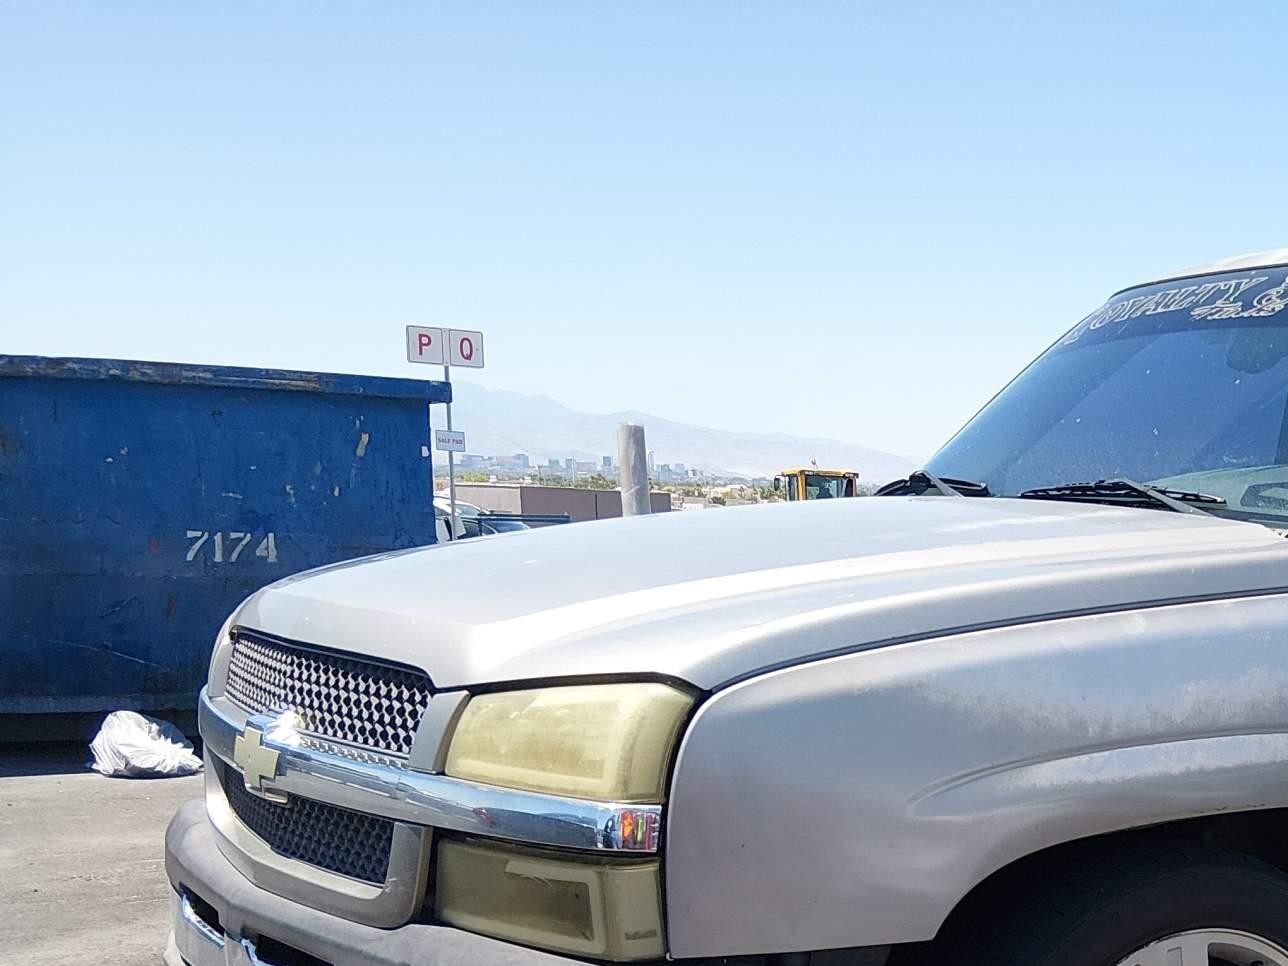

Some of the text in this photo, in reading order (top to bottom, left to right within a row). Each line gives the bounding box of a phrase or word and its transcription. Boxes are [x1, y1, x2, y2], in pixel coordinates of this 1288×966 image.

[417, 333, 432, 356] P
[459, 336, 474, 361] Q
[186, 530, 278, 562] 7174
